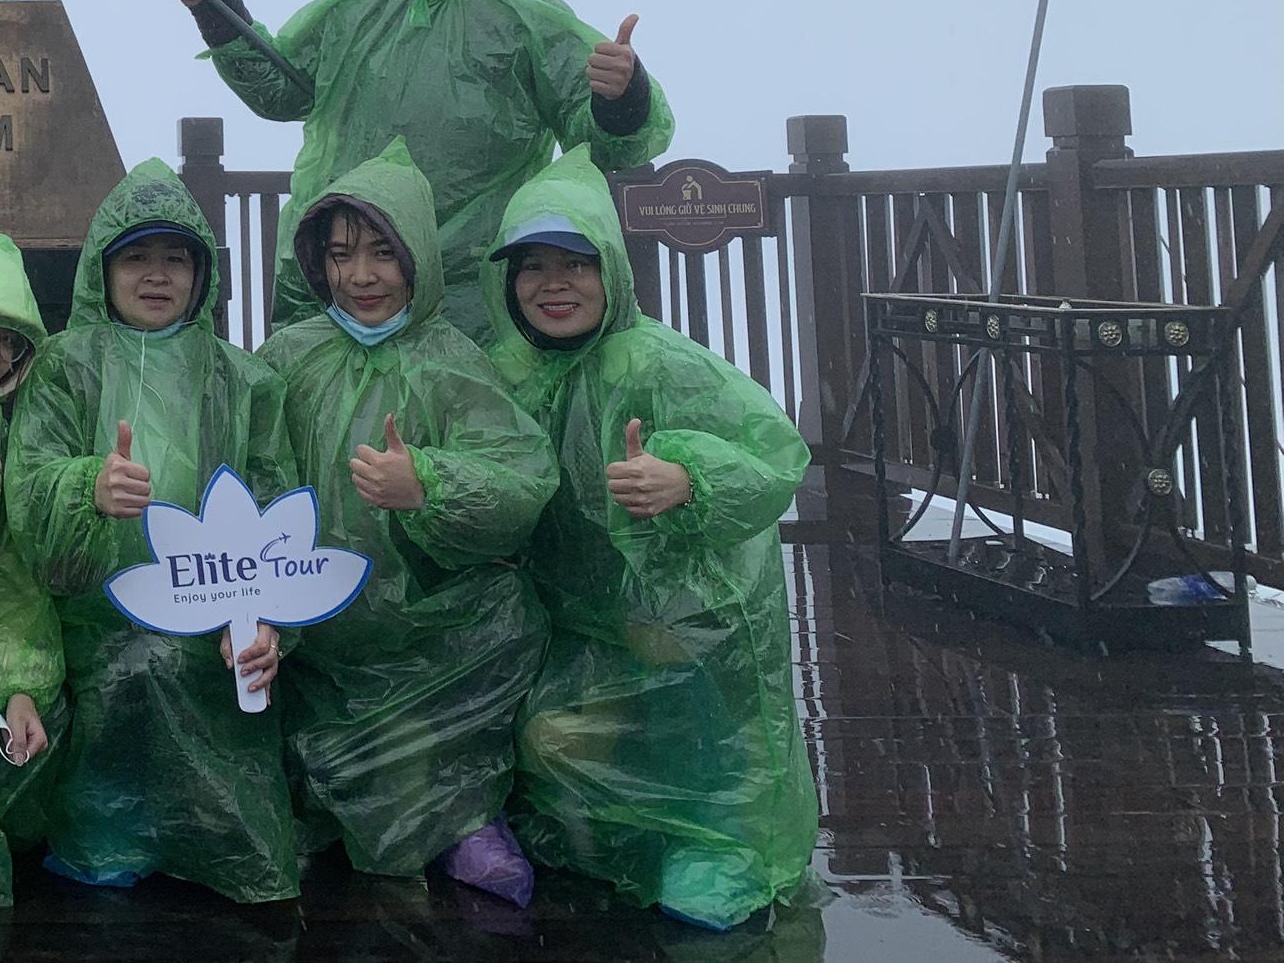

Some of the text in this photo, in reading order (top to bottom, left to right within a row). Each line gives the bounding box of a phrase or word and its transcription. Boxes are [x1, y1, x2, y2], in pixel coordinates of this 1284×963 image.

[638, 205, 654, 216] VUI
[655, 203, 677, 216] LÒNG
[706, 203, 726, 215] SINH
[727, 202, 756, 214] CHUNG
[166, 552, 329, 588] Elite Tour
[173, 587, 261, 604] Enjoy your life
